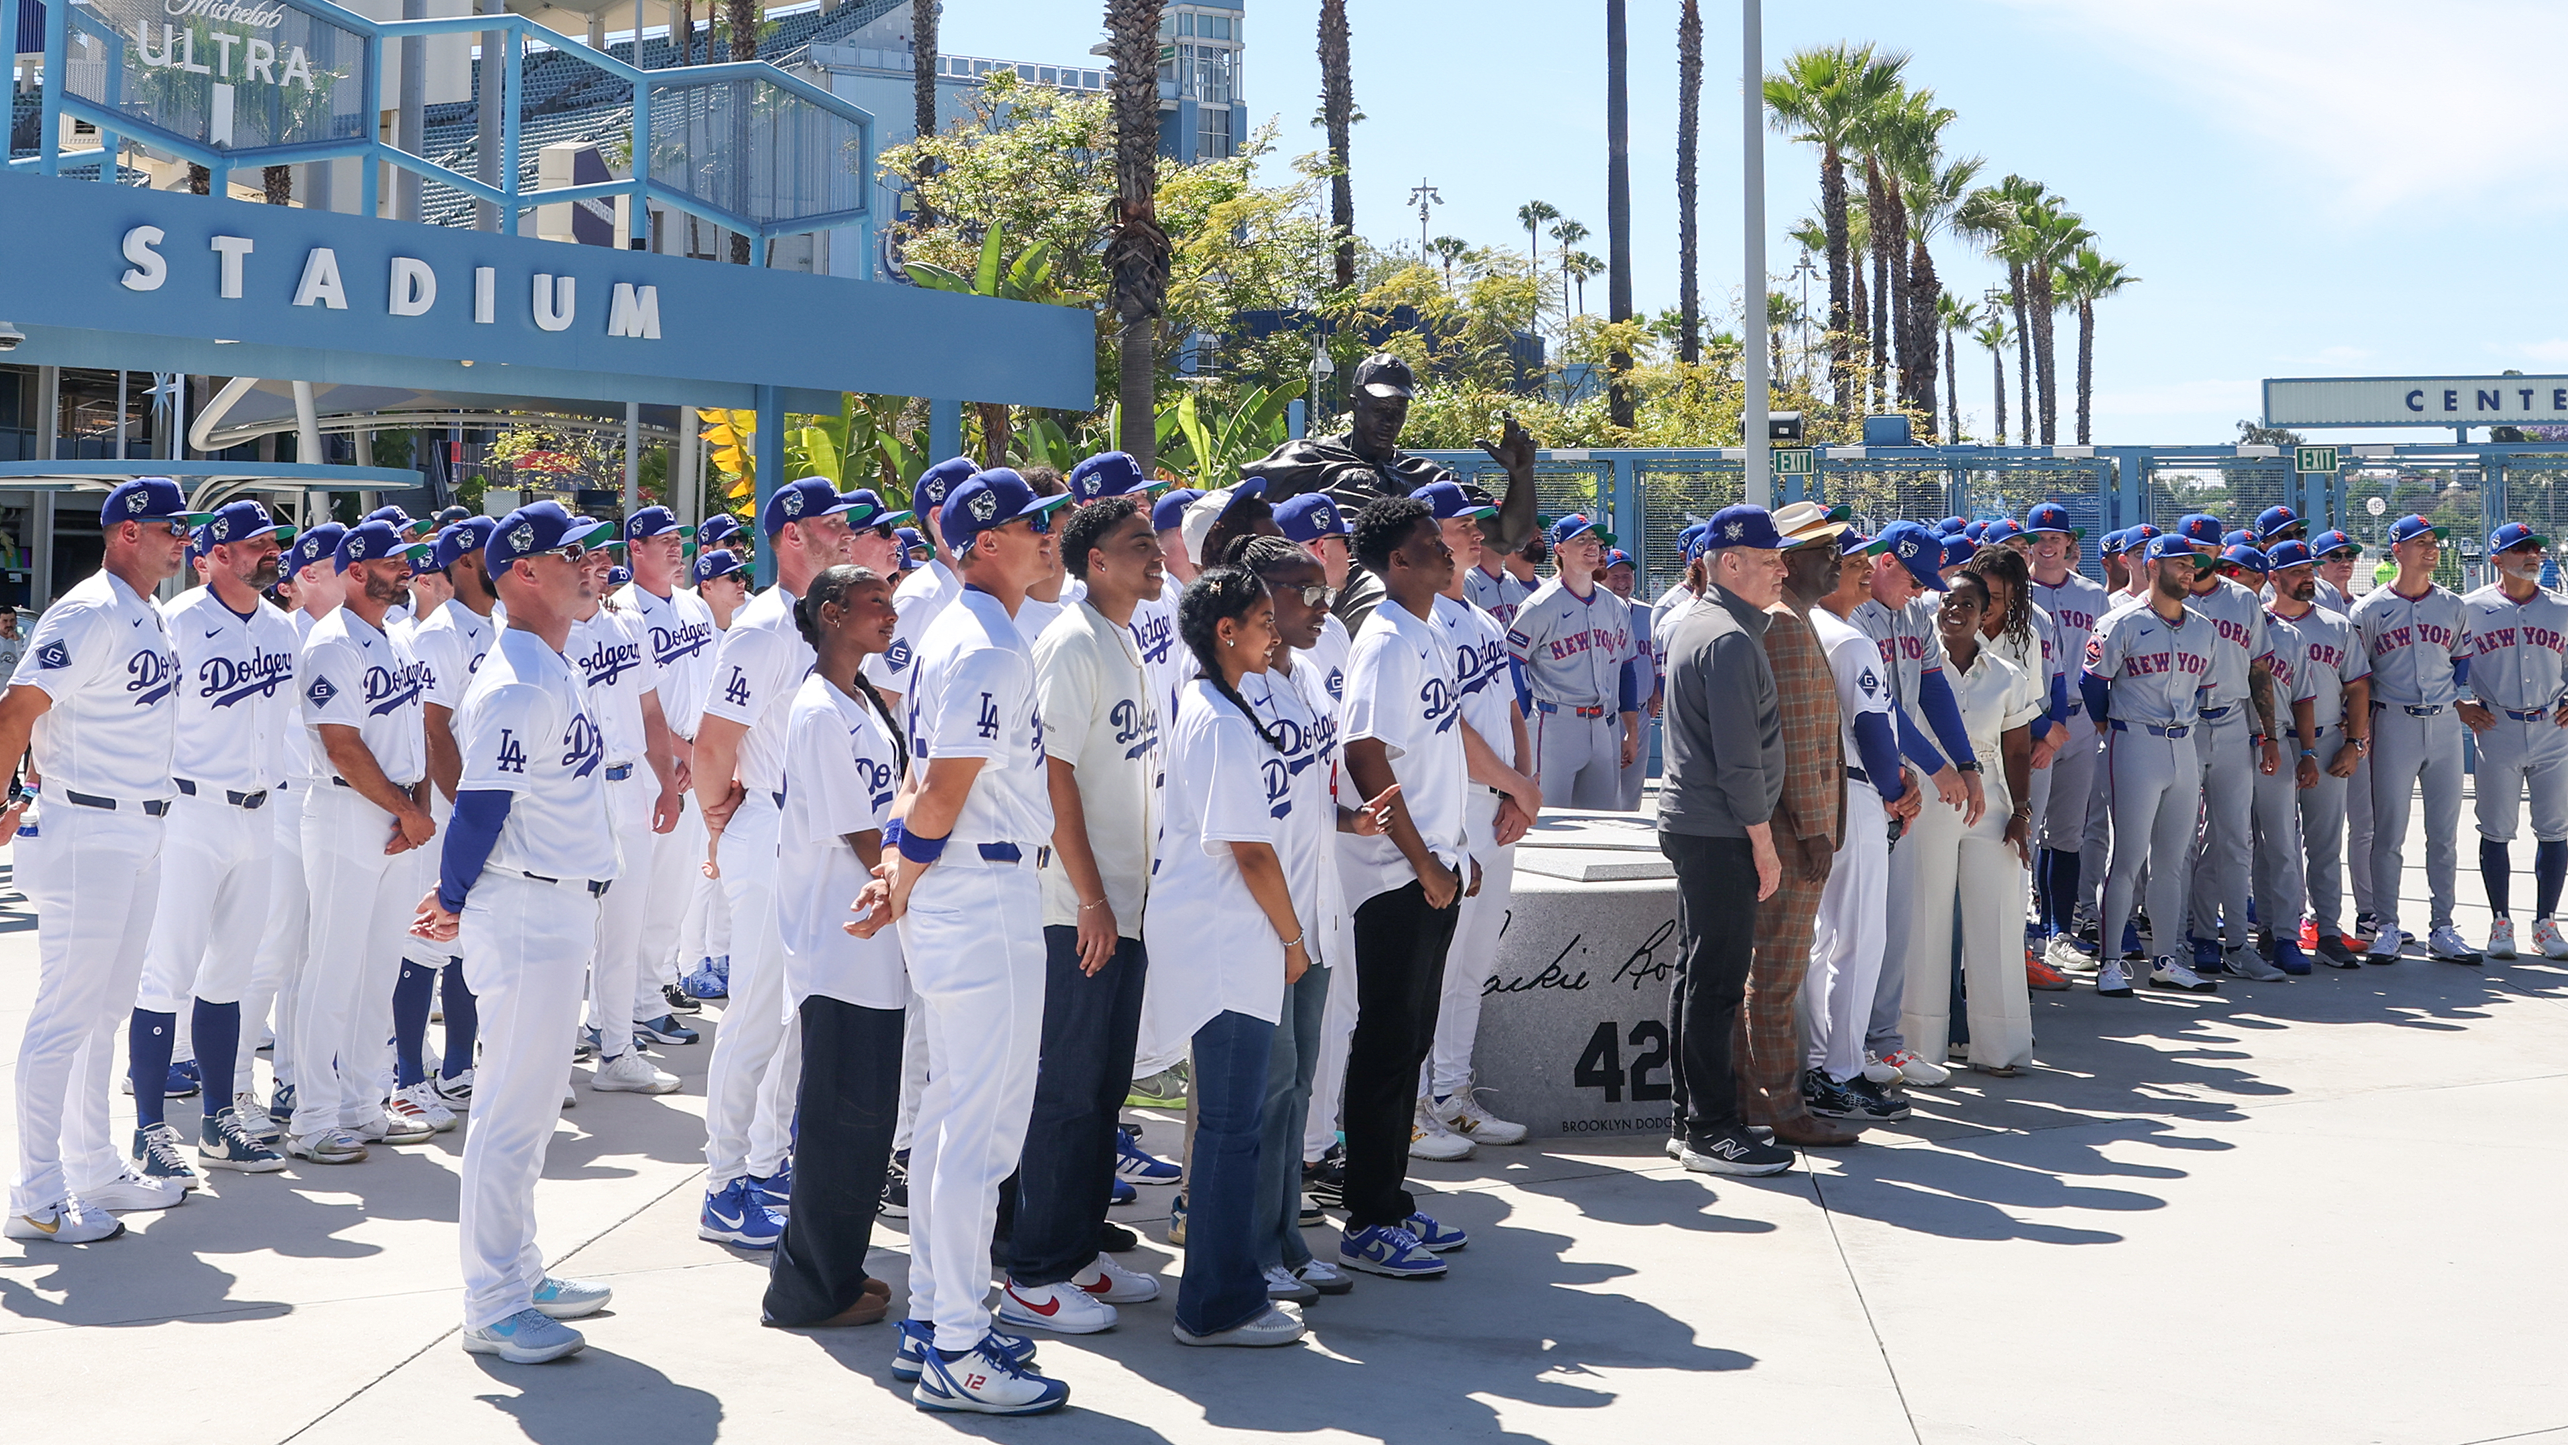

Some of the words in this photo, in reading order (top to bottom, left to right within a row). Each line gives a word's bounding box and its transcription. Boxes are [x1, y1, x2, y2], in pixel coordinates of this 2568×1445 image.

[137, 19, 315, 90] ULTRA
[121, 225, 661, 340] STADIUM
[1782, 452, 1809, 472] EXIT
[2302, 449, 2332, 471] EXIT
[617, 565, 628, 581] B
[1549, 630, 1590, 661] NEW
[2210, 618, 2251, 650] ORK
[2374, 626, 2413, 656] NEW
[2474, 627, 2516, 656] NEW
[2125, 651, 2171, 679] NEW
[726, 665, 750, 708] LA
[976, 691, 1000, 741] LA
[497, 728, 527, 774] LA
[1574, 1020, 1672, 1103] 42
[1562, 1117, 1632, 1133] BROOKLYN
[964, 1372, 987, 1391] 12
